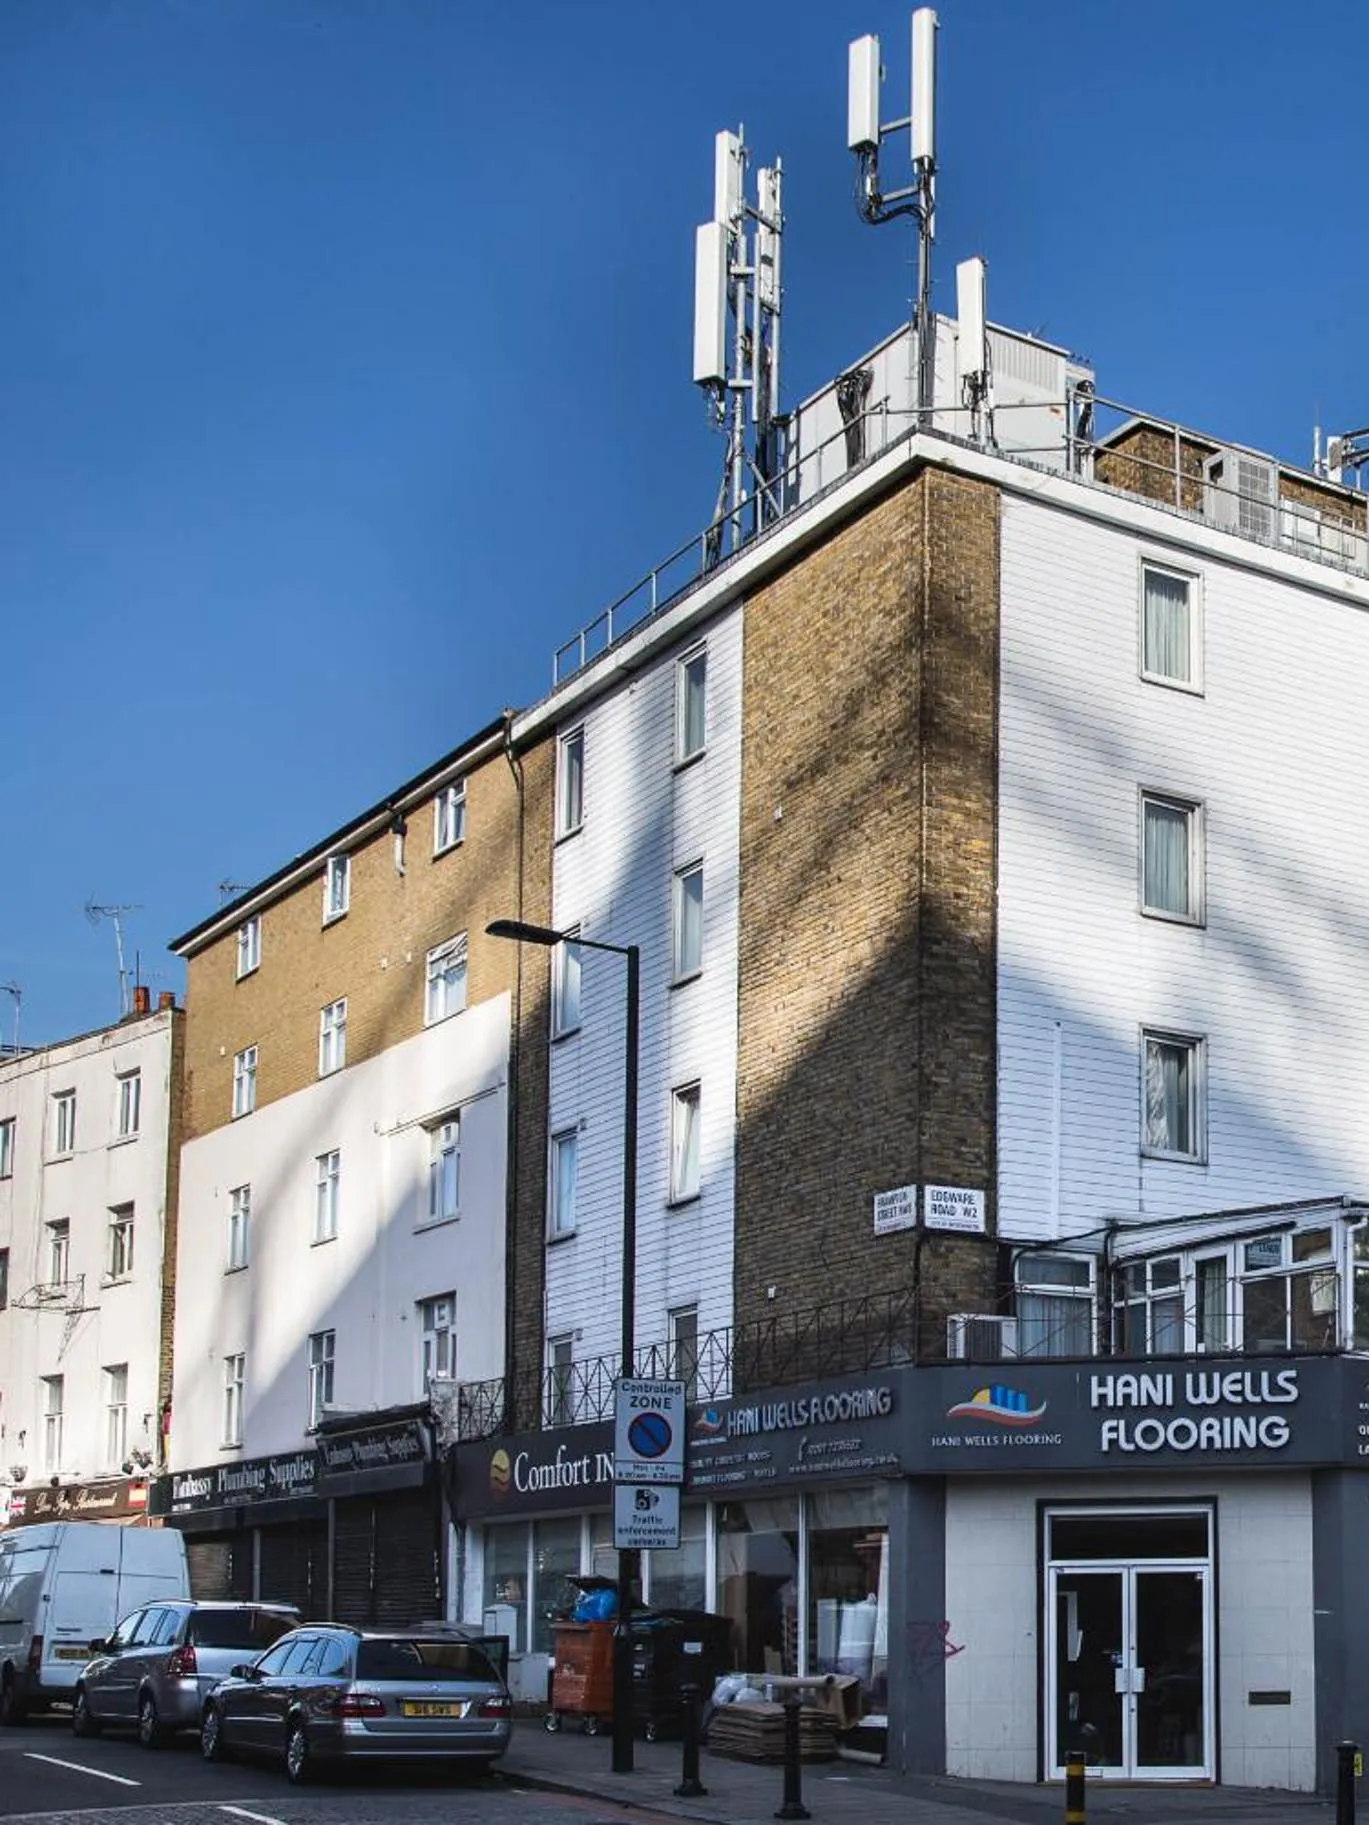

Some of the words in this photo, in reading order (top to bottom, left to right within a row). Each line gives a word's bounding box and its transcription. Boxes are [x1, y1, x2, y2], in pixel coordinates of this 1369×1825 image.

[931, 1189, 975, 1205] EDGWARE
[931, 1204, 957, 1217] ROAD
[962, 1207, 978, 1218] W2
[622, 1382, 682, 1395] Controlled
[1091, 1374, 1173, 1407] HANI
[1186, 1370, 1299, 1404] WELLS
[630, 1396, 673, 1410] ZONE
[727, 1405, 760, 1437] HANI
[762, 1401, 810, 1432] WELLS
[811, 1387, 892, 1424] FLOORING
[932, 1437, 960, 1447] HANI
[965, 1436, 999, 1446] WELLS
[1003, 1433, 1063, 1446] FLOORING
[1101, 1415, 1291, 1451] FLOORING
[173, 1474, 212, 1501] Embassy
[217, 1463, 266, 1493] Plumbing
[270, 1454, 315, 1490] Supplies
[514, 1444, 590, 1492] Comfort
[595, 1452, 615, 1482] IN
